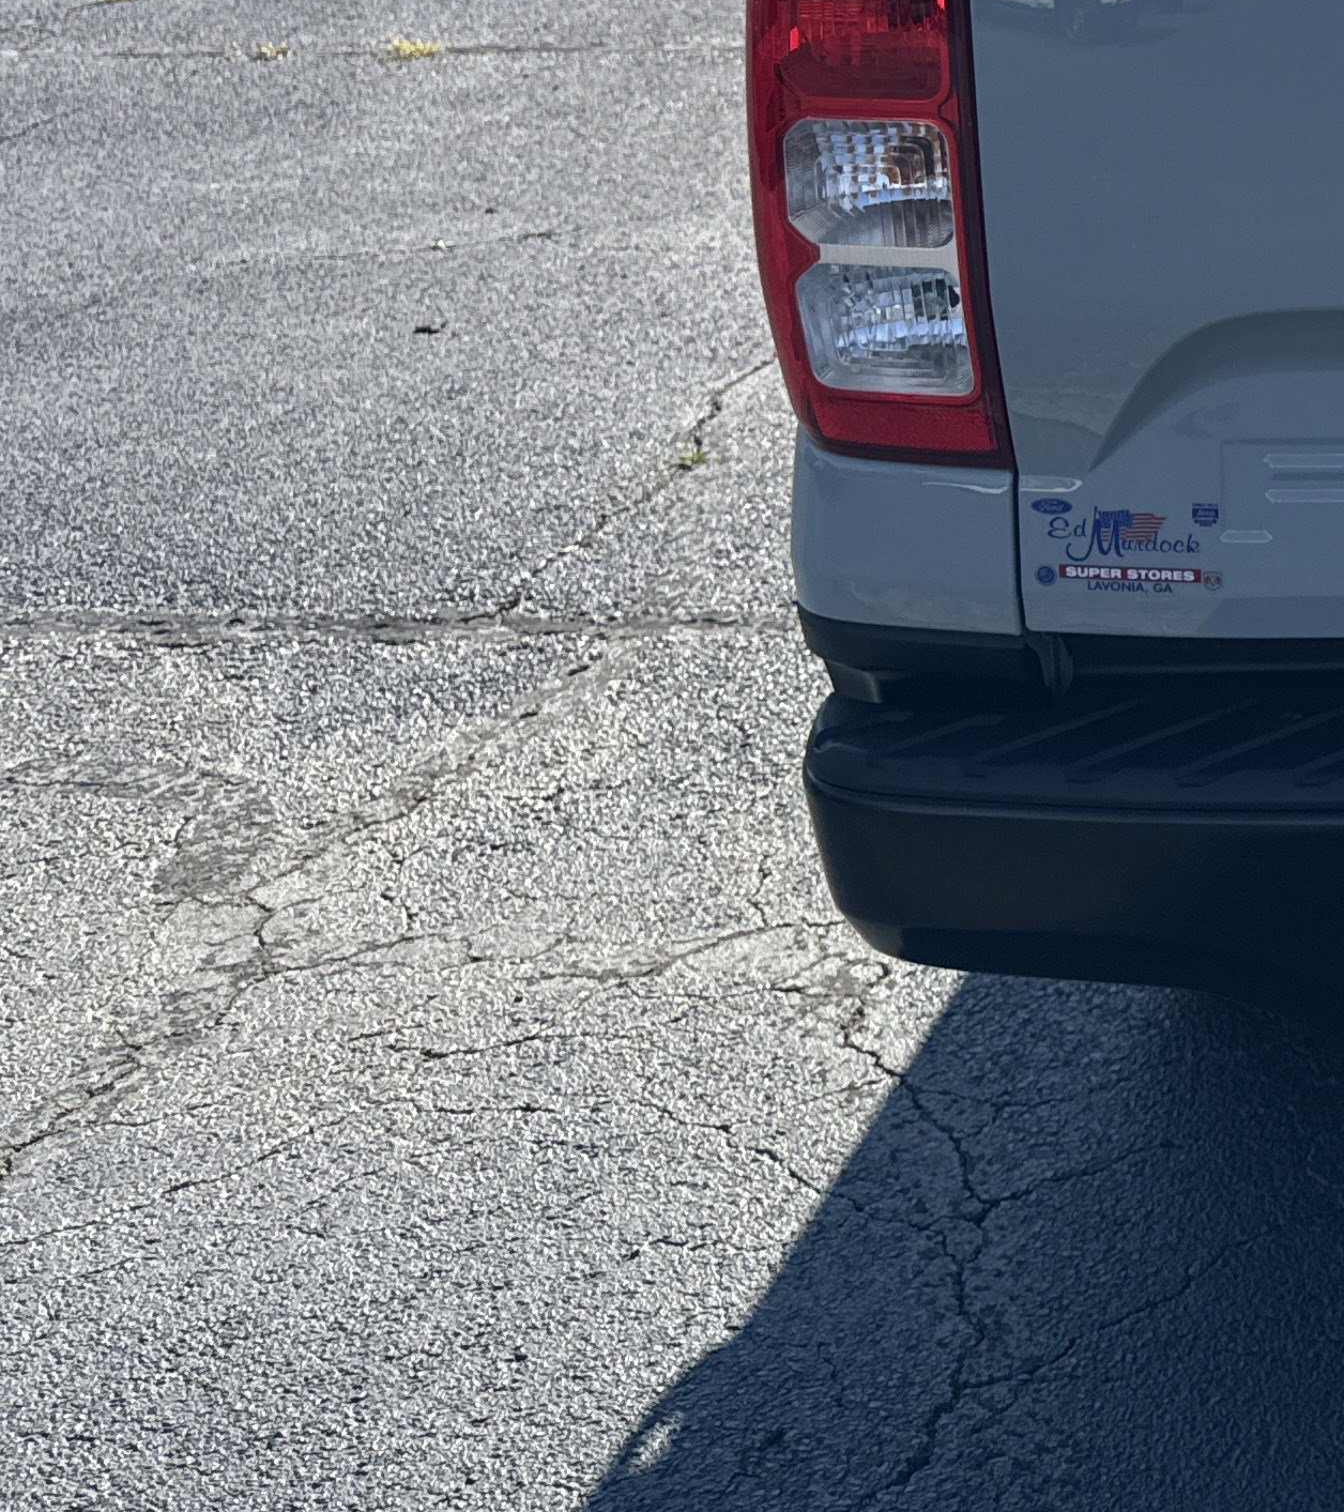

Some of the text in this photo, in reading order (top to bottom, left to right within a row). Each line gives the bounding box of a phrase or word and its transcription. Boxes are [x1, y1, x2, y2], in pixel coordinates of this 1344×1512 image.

[1047, 506, 1201, 561] Ed Murdock
[1065, 565, 1195, 582] SUPER STORES
[1153, 583, 1173, 594] GA
